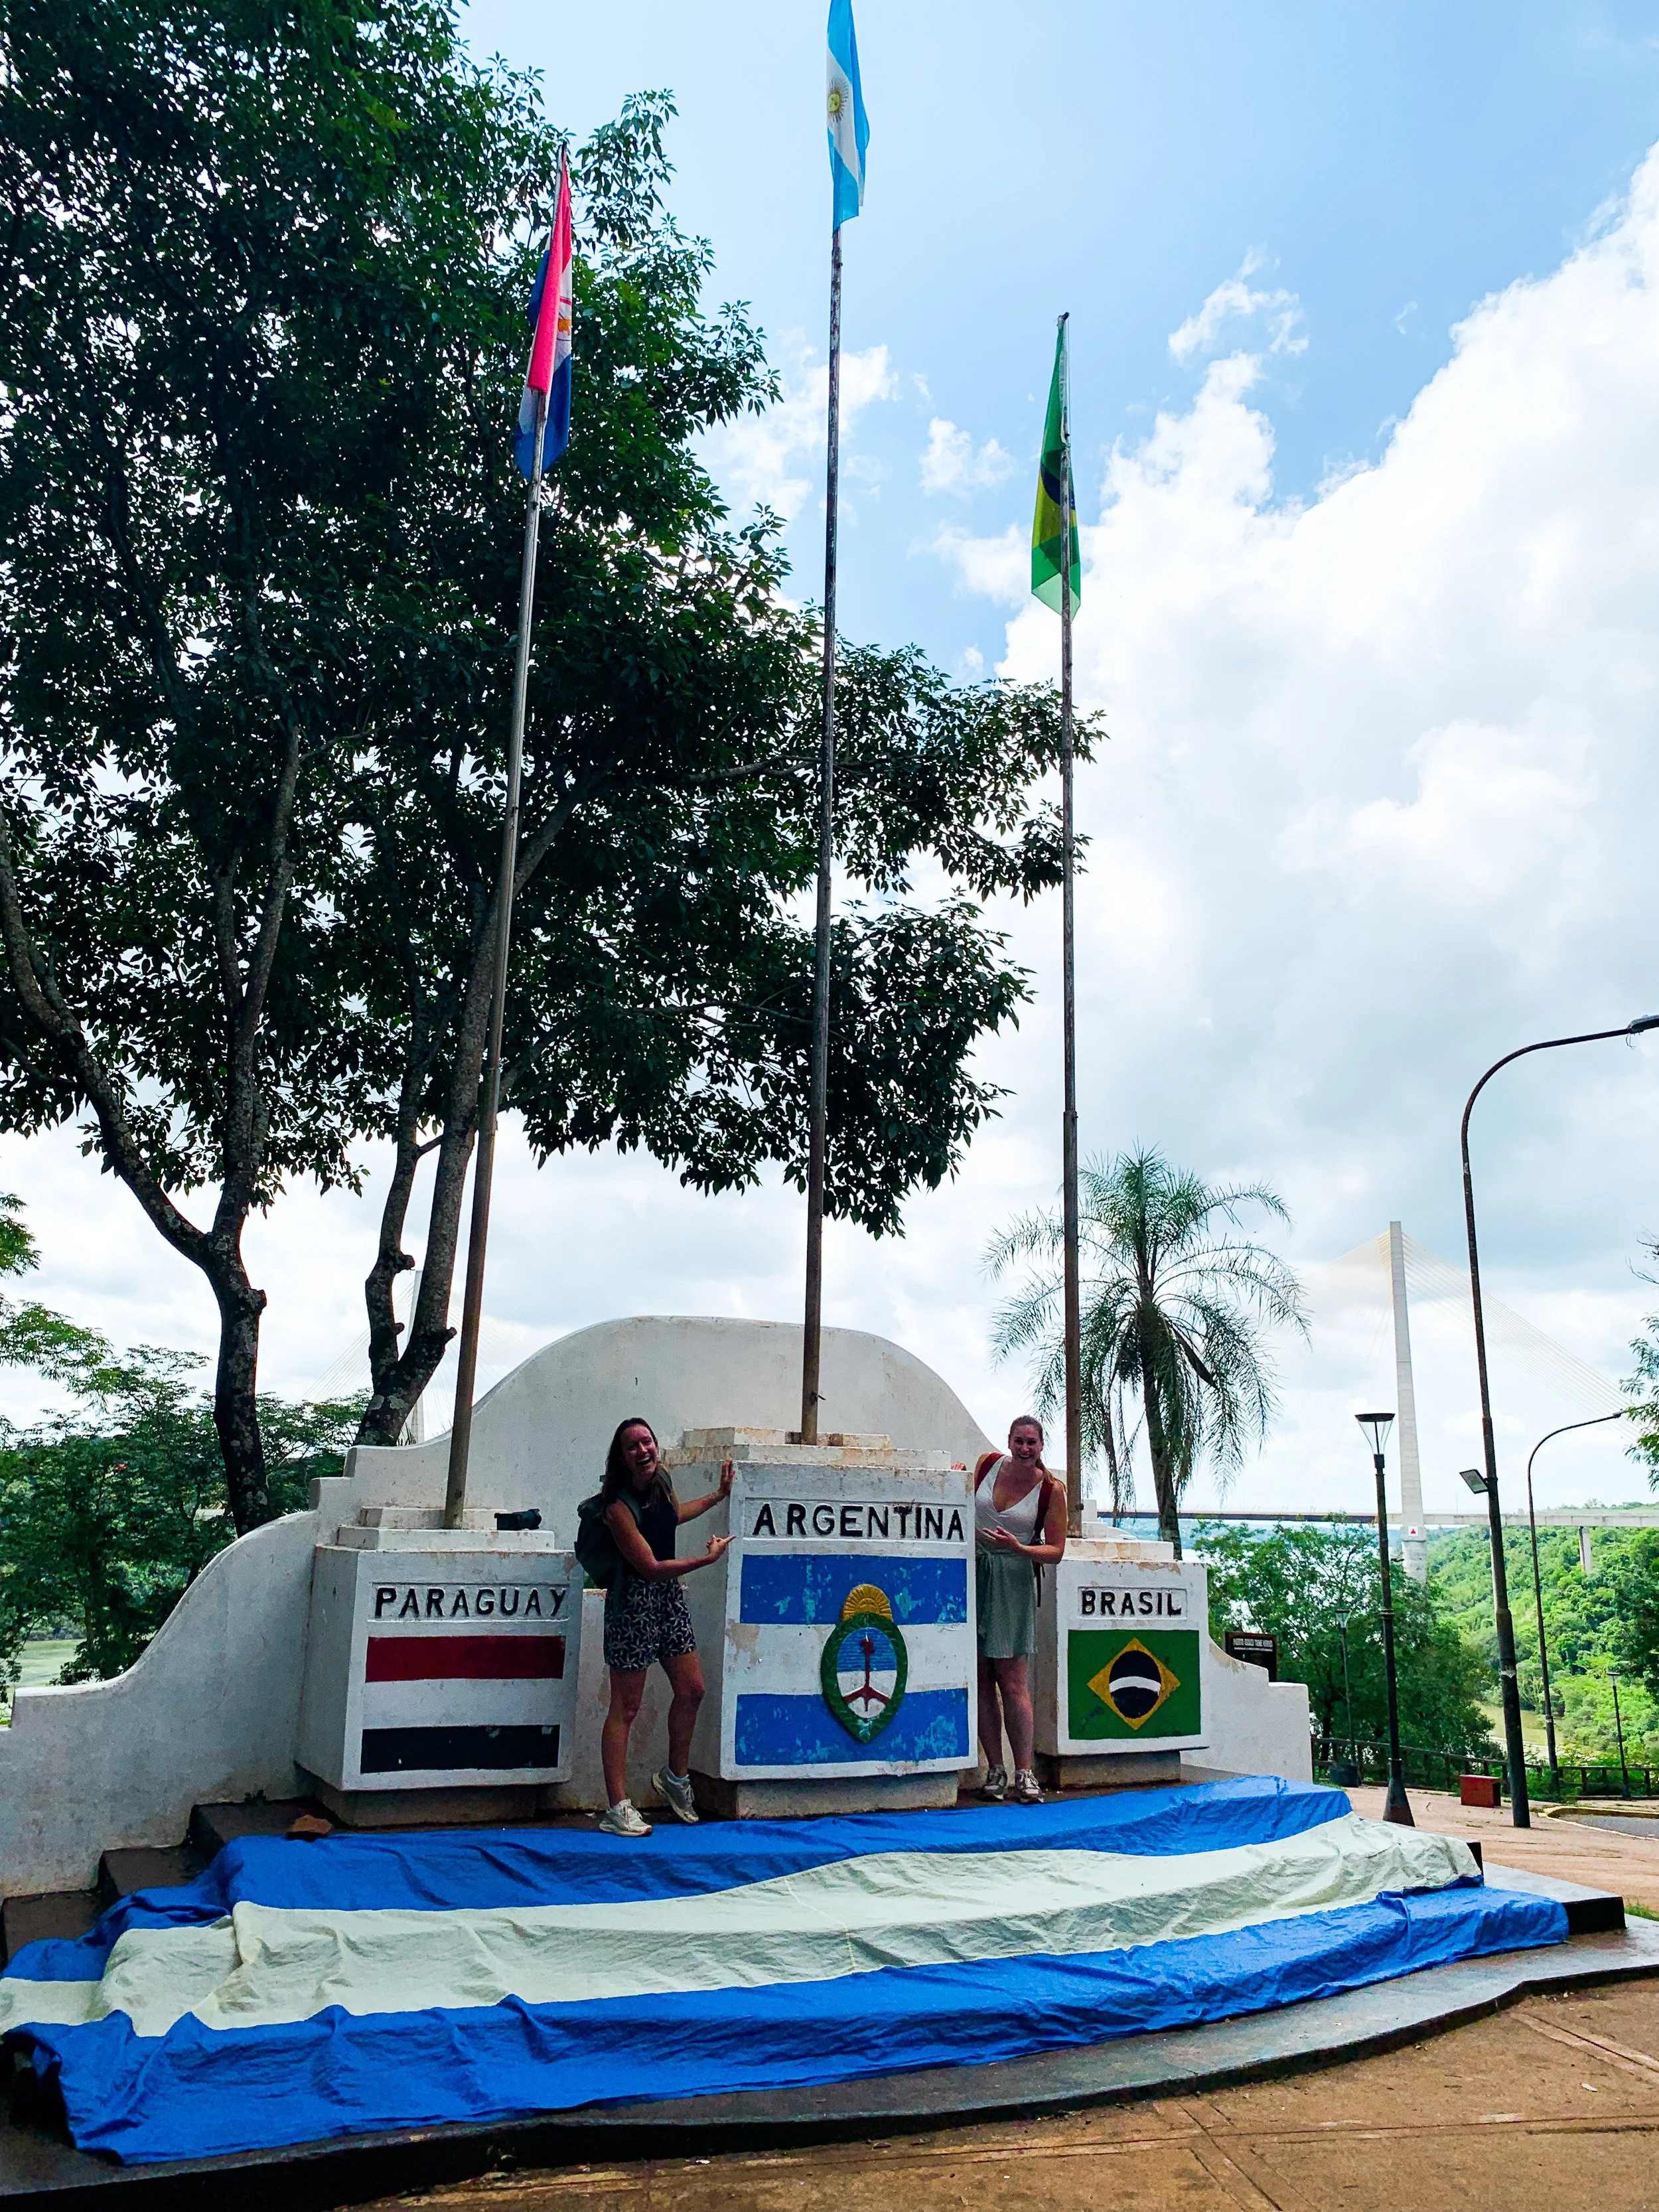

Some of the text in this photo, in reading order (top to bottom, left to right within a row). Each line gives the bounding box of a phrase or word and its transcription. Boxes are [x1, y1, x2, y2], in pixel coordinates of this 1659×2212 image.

[752, 1503, 965, 1542] ARGENTINA
[375, 1586, 567, 1619] PARAGUAY
[1081, 1589, 1182, 1616] BRASIL
